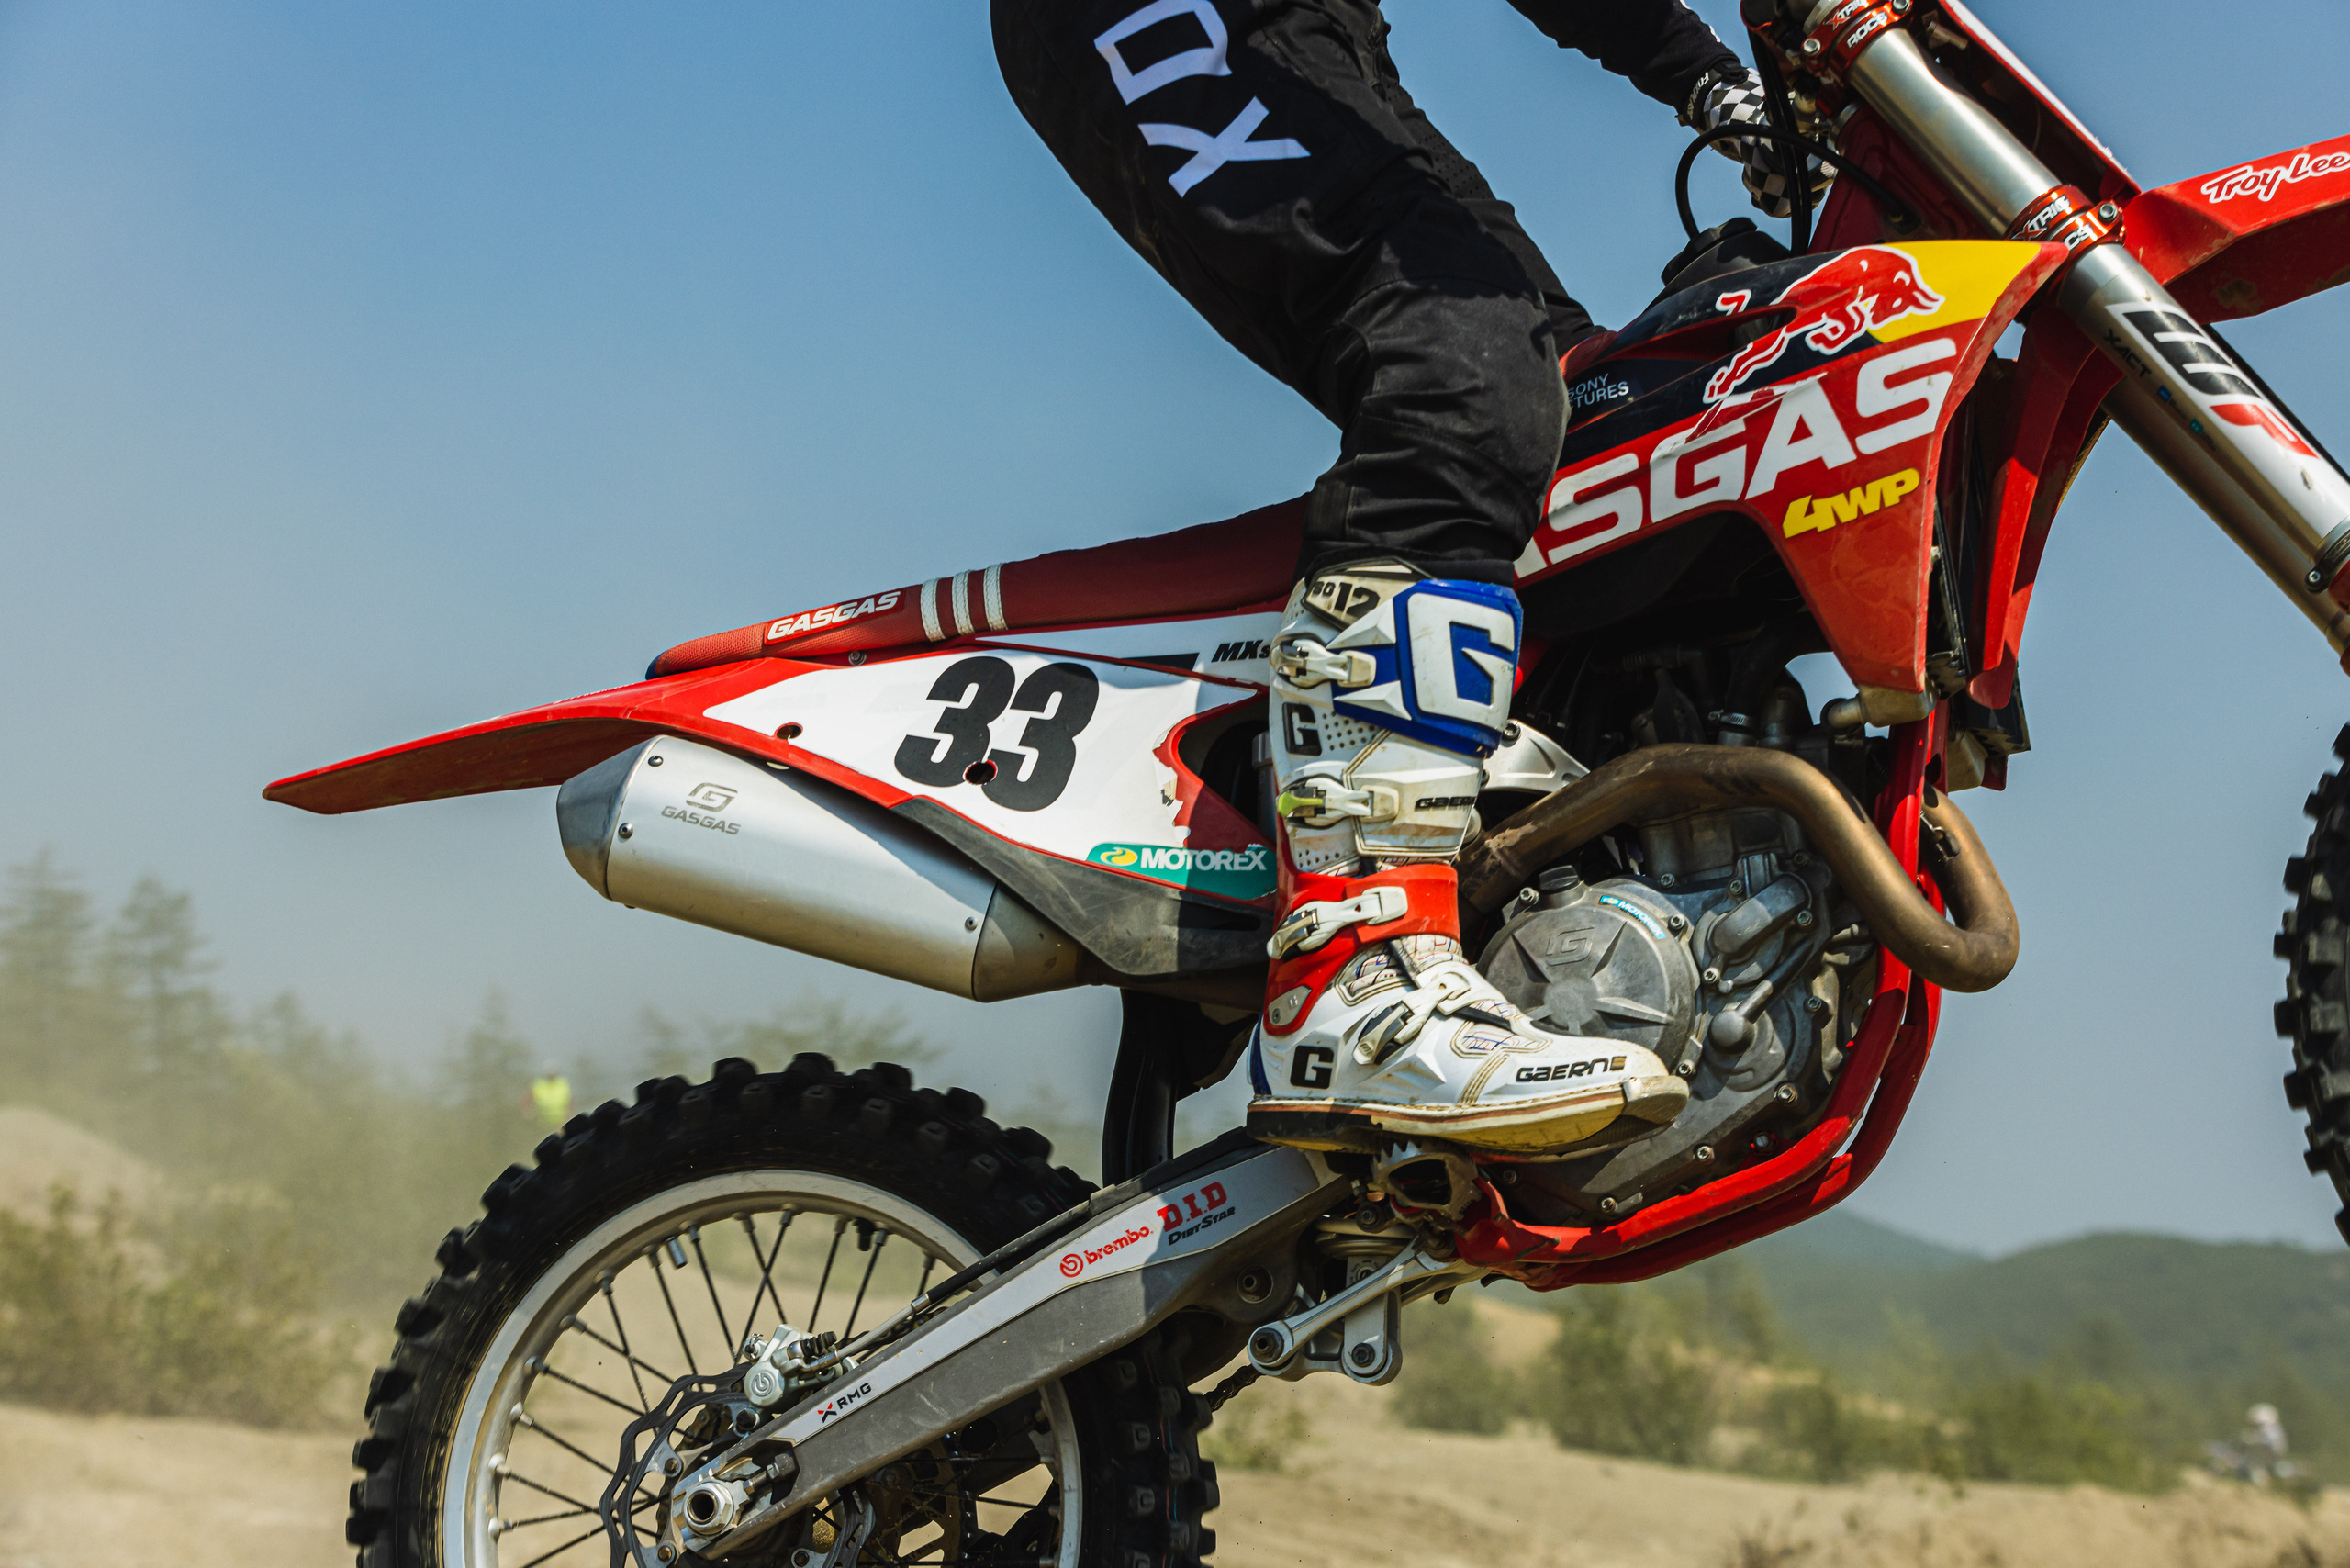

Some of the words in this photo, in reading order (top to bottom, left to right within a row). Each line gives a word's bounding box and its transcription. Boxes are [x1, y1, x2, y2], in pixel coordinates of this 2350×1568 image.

[1846, 11, 1888, 48] ROCS
[2200, 165, 2287, 204] Troy
[2285, 151, 2350, 184] Lee
[2064, 223, 2098, 252] CS
[2104, 328, 2153, 378] XACT
[1569, 381, 1629, 409] TURES
[767, 591, 901, 640] GASGAS
[894, 655, 1100, 812] 33
[661, 805, 742, 835] GASGAS
[1140, 847, 1268, 871] MOTOREX
[1617, 900, 1664, 937] MOTOREX
[1157, 1182, 1227, 1233] D.I.D
[1083, 1226, 1151, 1265] brembo
